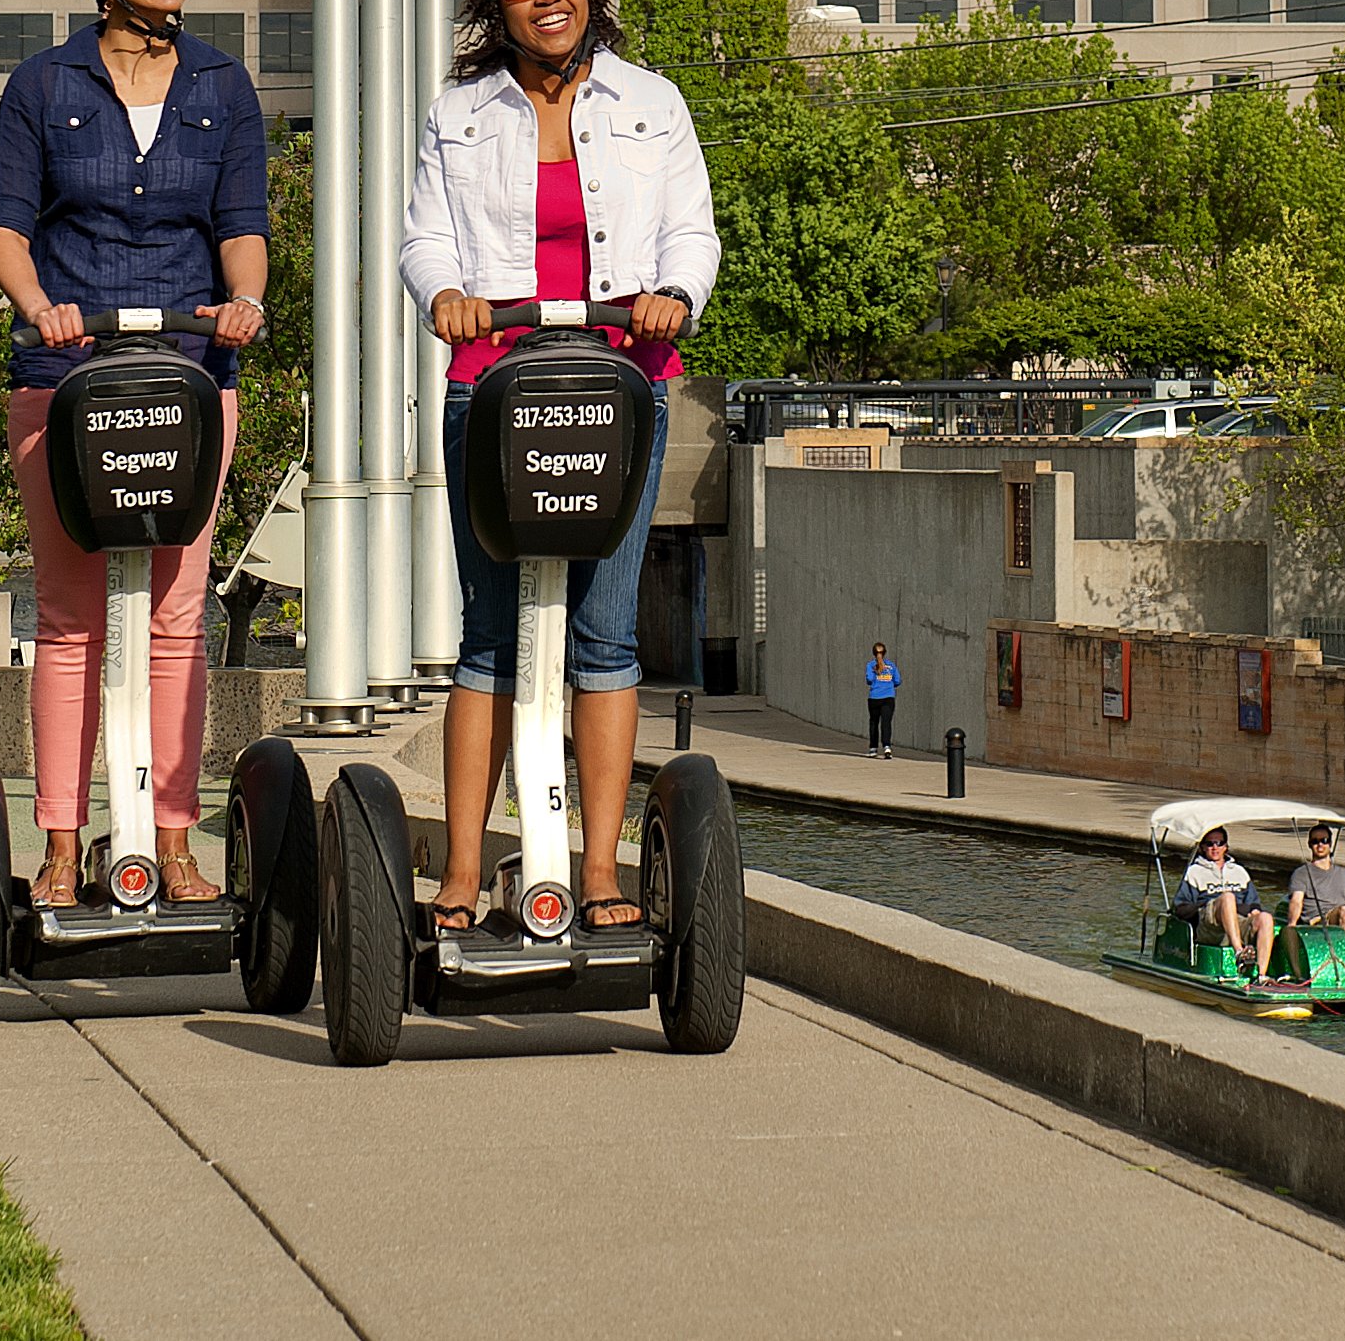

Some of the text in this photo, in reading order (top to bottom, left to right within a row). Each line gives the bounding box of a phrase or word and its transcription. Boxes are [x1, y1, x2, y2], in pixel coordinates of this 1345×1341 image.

[86, 405, 183, 432] 317-253-1910
[512, 403, 614, 429] 317-253-1910
[101, 450, 179, 474] Segway
[525, 450, 607, 476] Segway
[110, 487, 174, 509] Tours
[532, 491, 598, 513] Tours
[106, 551, 124, 668] EGWAY
[135, 766, 149, 791] 7
[548, 785, 563, 812] 5
